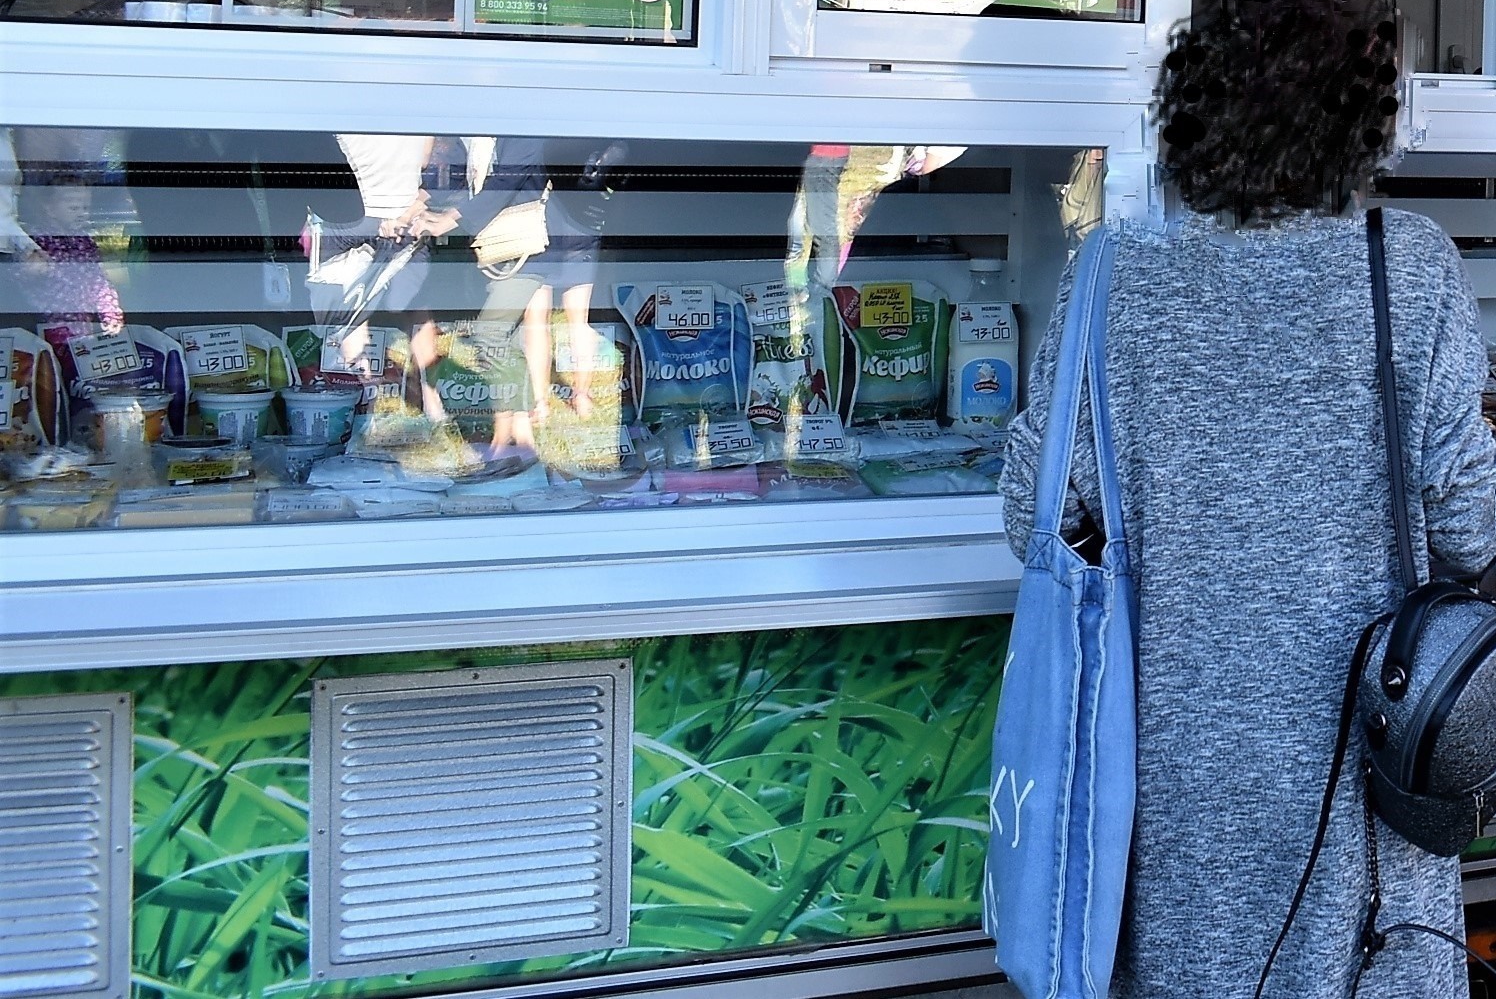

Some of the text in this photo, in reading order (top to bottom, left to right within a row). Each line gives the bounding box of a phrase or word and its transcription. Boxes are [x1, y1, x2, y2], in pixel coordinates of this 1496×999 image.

[481, 0, 548, 11] 8 800 333 95 94
[668, 313, 710, 327] 46.00
[661, 349, 715, 361] натуральное
[874, 342, 922, 357] натуральный
[862, 352, 931, 382] Кефир
[435, 378, 519, 406] Кефир
